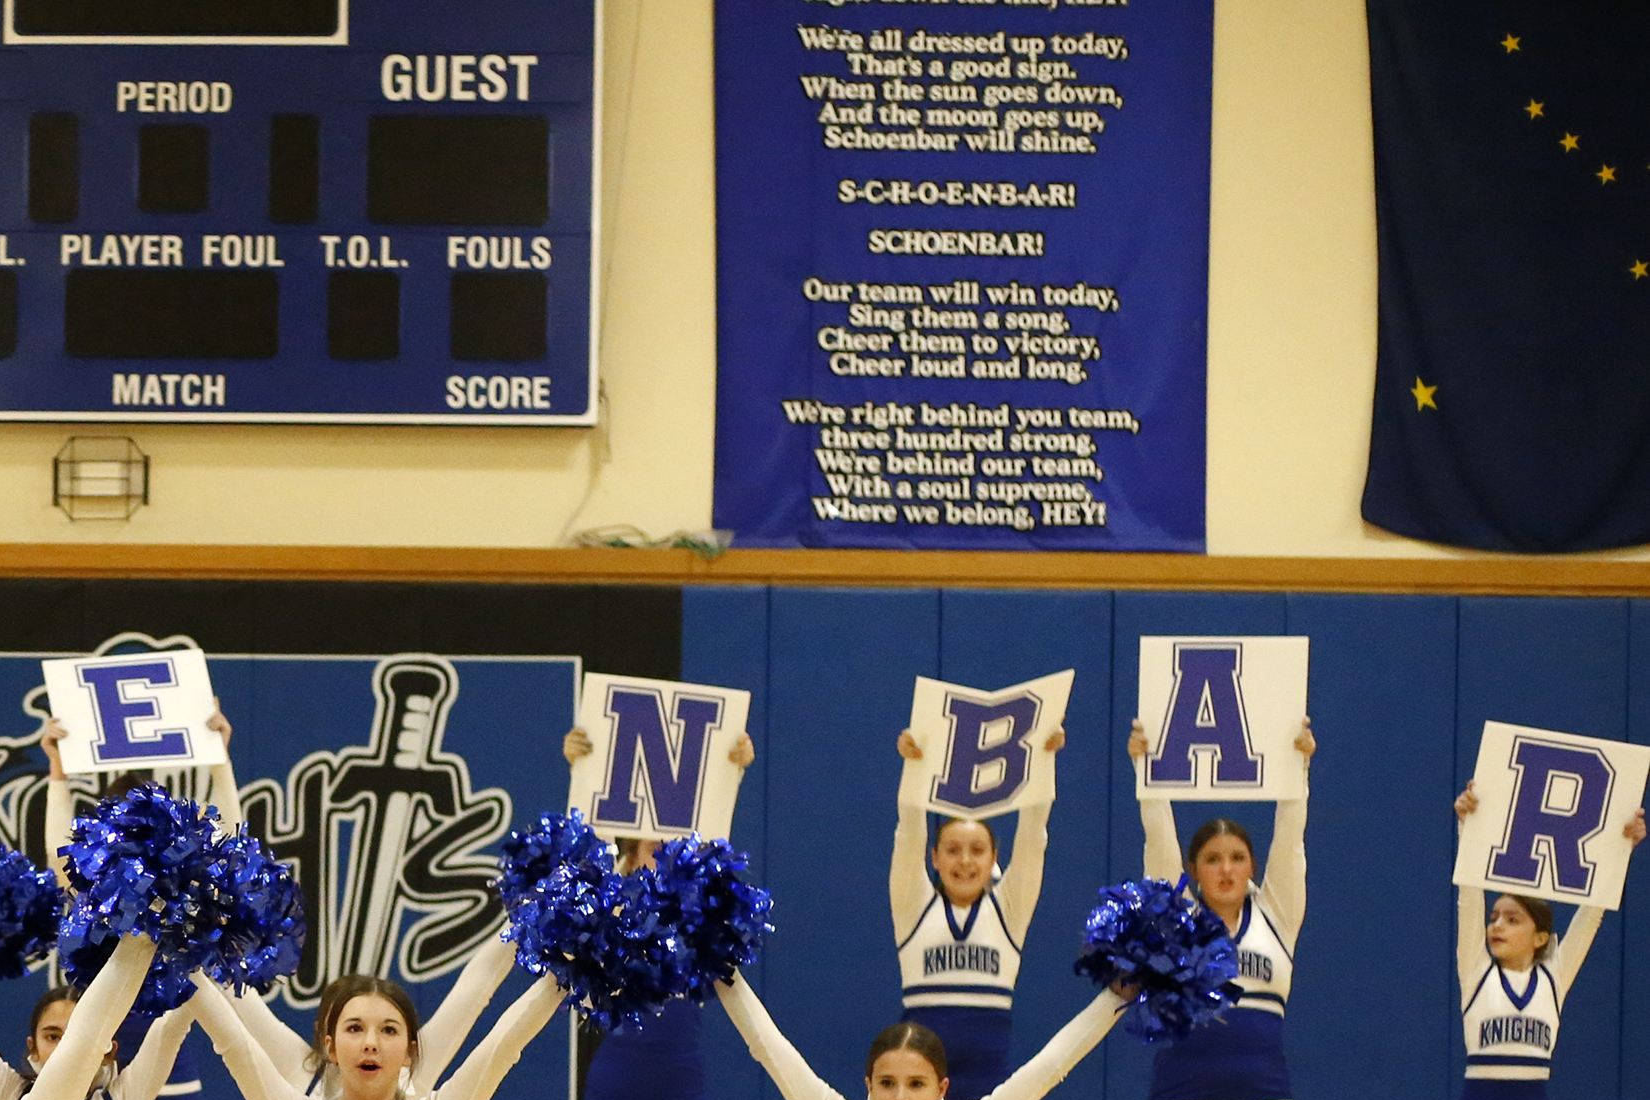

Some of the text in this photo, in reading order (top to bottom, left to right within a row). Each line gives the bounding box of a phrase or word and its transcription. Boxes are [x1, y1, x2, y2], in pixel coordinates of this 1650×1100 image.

[798, 24, 1129, 61] We're all dressed up today,
[381, 53, 539, 102] GUEST
[847, 52, 1078, 83] That's a good sign.
[117, 81, 233, 114] PERIOD
[800, 76, 1124, 109] When the sun goes down,
[818, 102, 1106, 134] And the moon goes up,
[824, 127, 1097, 154] Schoenbar will shine.
[838, 180, 1076, 208] S-C-H-O-E-N-B-A-R!
[60, 234, 285, 267] PLAYER FOUL
[320, 235, 409, 268] T.O.L.
[447, 236, 552, 269] FOULS
[868, 229, 1045, 256] SCHOENBAR!
[803, 277, 1120, 312] Our team will win today,
[849, 303, 1070, 334] Sing them a song.
[817, 326, 1102, 361] Cheer them to victory,
[828, 352, 1088, 385] Cheer loud and long.
[112, 373, 225, 407] MATCH
[445, 375, 551, 410] SCORE
[782, 400, 1141, 434] We're right behind you team,
[820, 426, 1097, 458] three hundred strong.
[814, 448, 1103, 482] We're behind our team,
[825, 473, 1093, 505] With a soul supreme,
[811, 497, 1107, 531] Where we belong, HEY!
[74, 656, 196, 765] E
[1145, 642, 1264, 789] A
[590, 684, 725, 833] N
[930, 690, 1043, 810] B
[1485, 735, 1616, 897] R
[923, 943, 1001, 977] KNIGHTS
[1480, 1016, 1551, 1051] KNIGHTS
